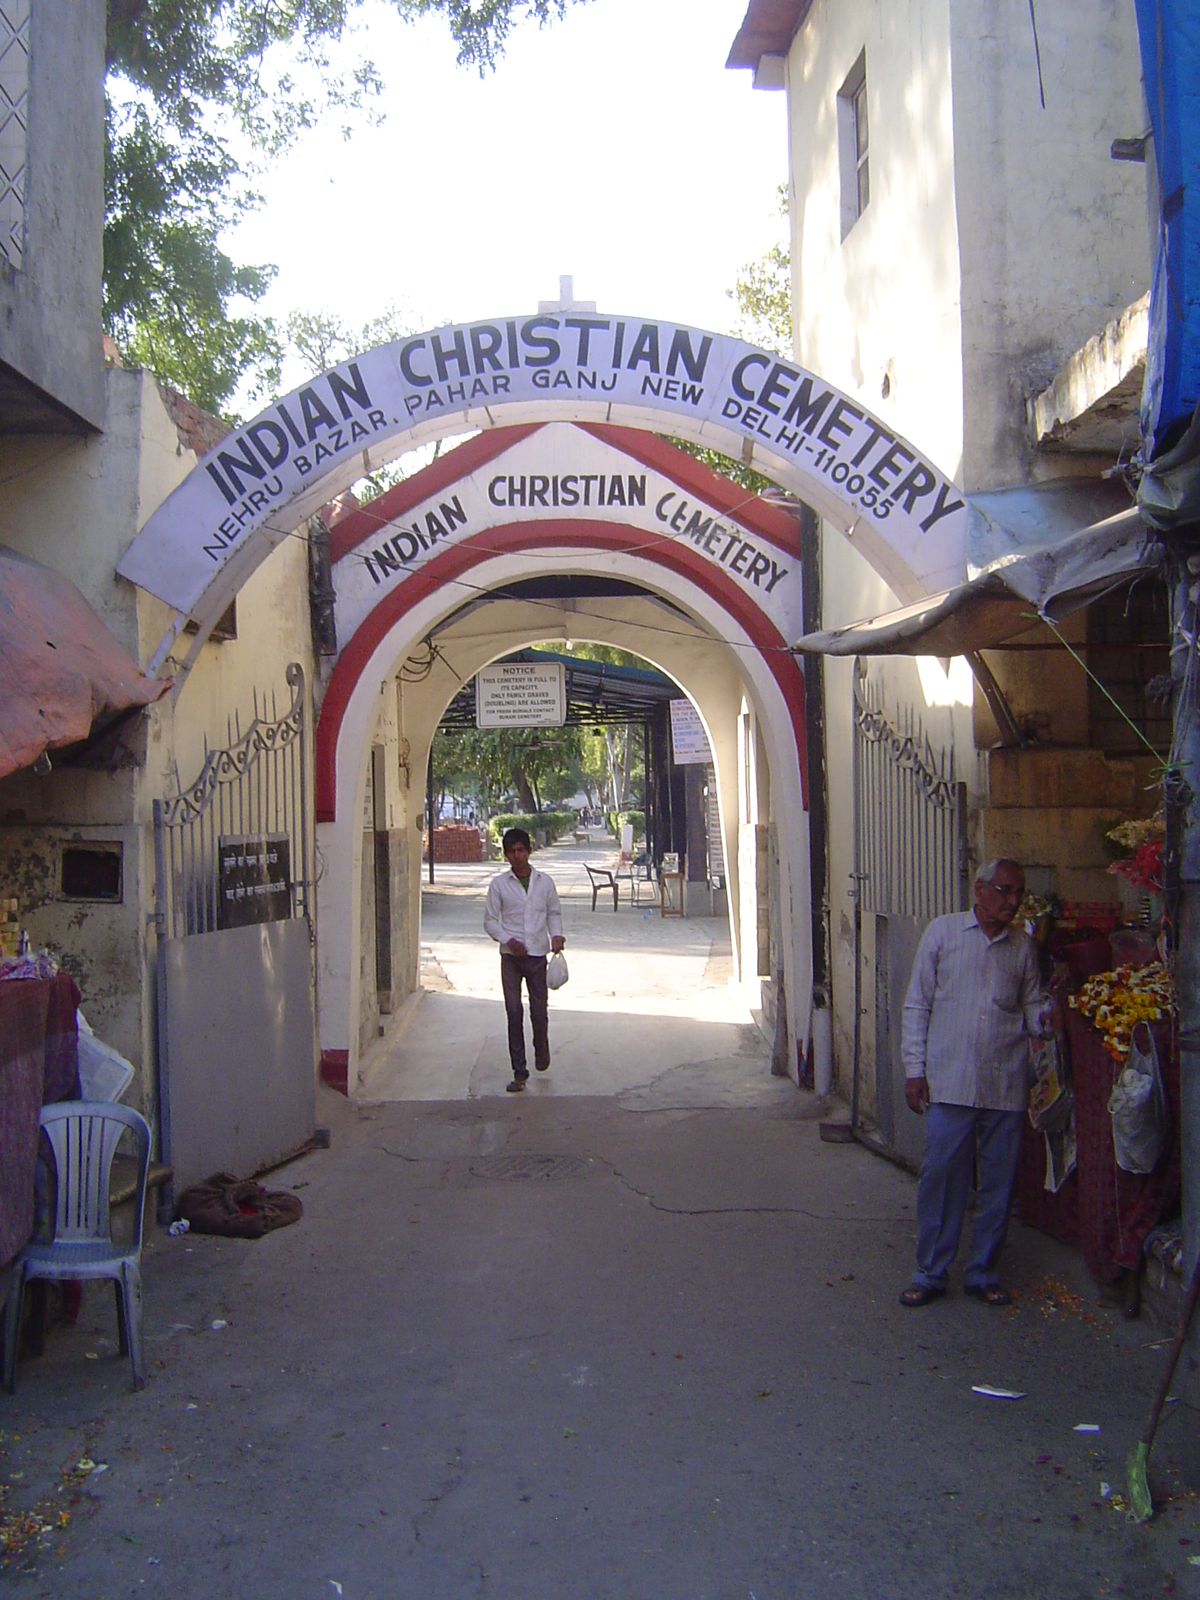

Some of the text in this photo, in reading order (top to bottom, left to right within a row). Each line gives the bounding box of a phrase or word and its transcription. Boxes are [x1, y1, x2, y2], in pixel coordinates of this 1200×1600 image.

[203, 477, 284, 562] NEHRU
[404, 374, 511, 415] PAHAR
[532, 369, 618, 391] GANJ
[641, 377, 705, 406] NEW
[722, 398, 895, 520] DELHI-110055
[206, 318, 965, 534] INDIAN CHRISTIAN CEMETERY
[364, 475, 788, 594] INDIAN CHRISTIAN CEMETERY
[503, 667, 536, 675] NOTICE
